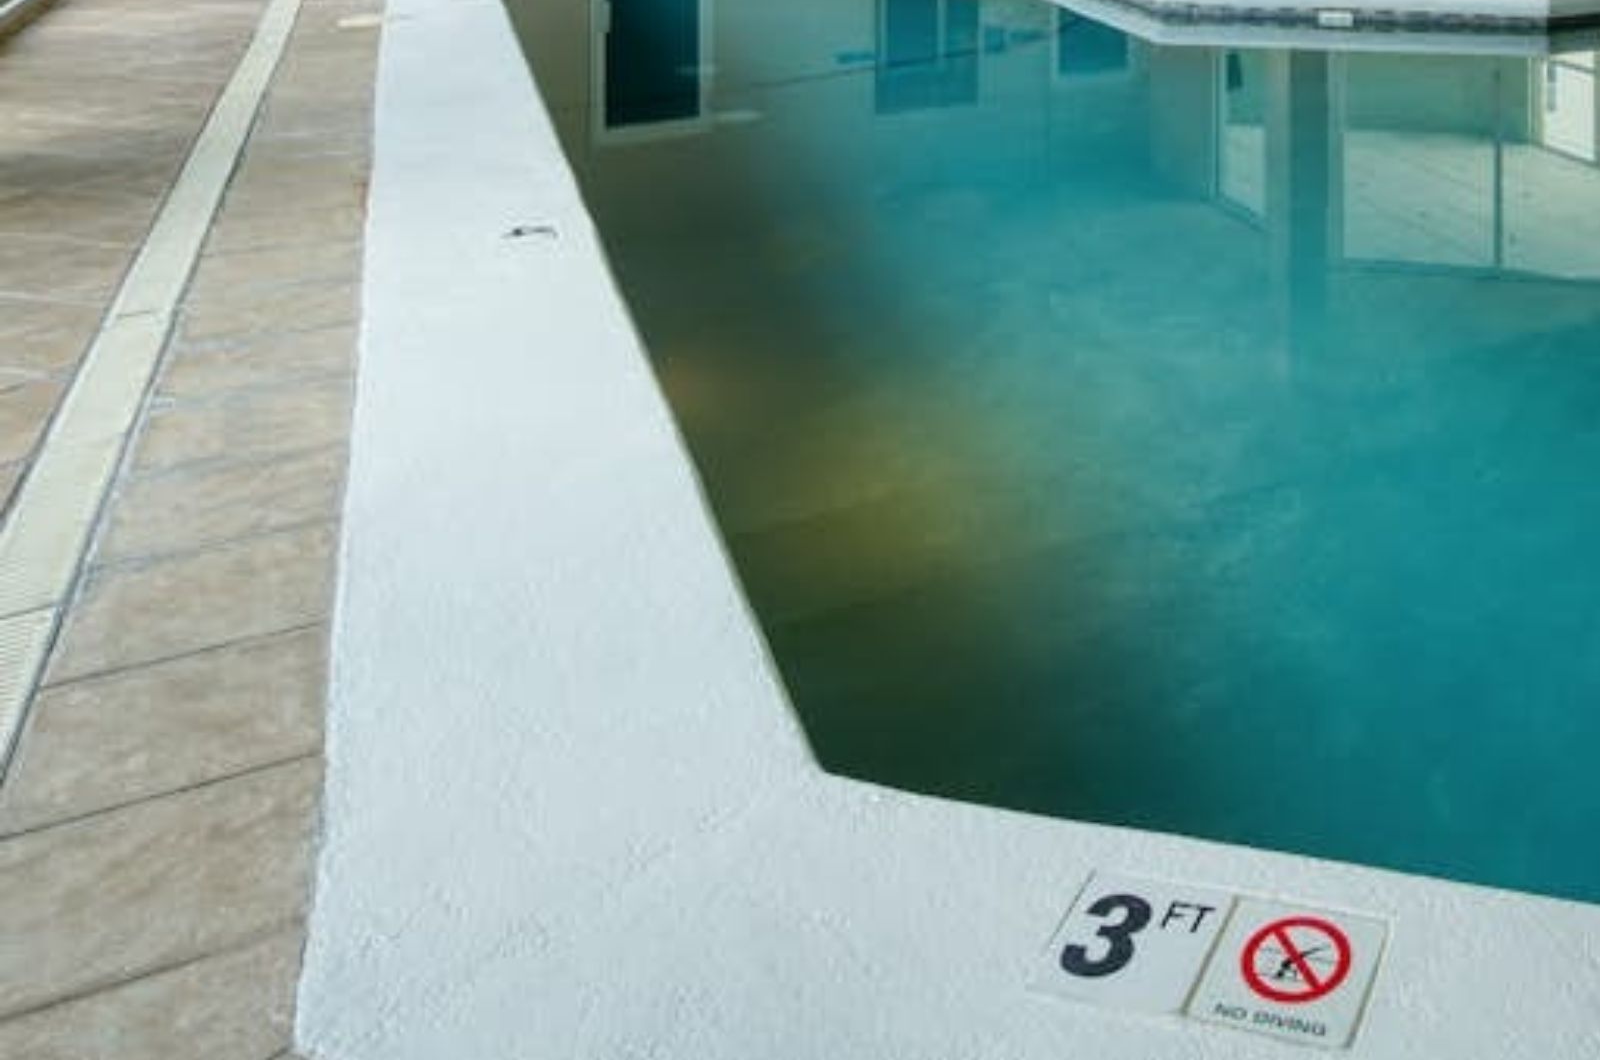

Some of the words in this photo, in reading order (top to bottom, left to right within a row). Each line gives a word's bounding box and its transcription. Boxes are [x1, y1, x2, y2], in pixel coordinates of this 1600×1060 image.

[1160, 900, 1216, 933] FT
[1060, 893, 1152, 977] 3
[1214, 1003, 1248, 1021] NO
[1252, 1010, 1327, 1036] DIVING
